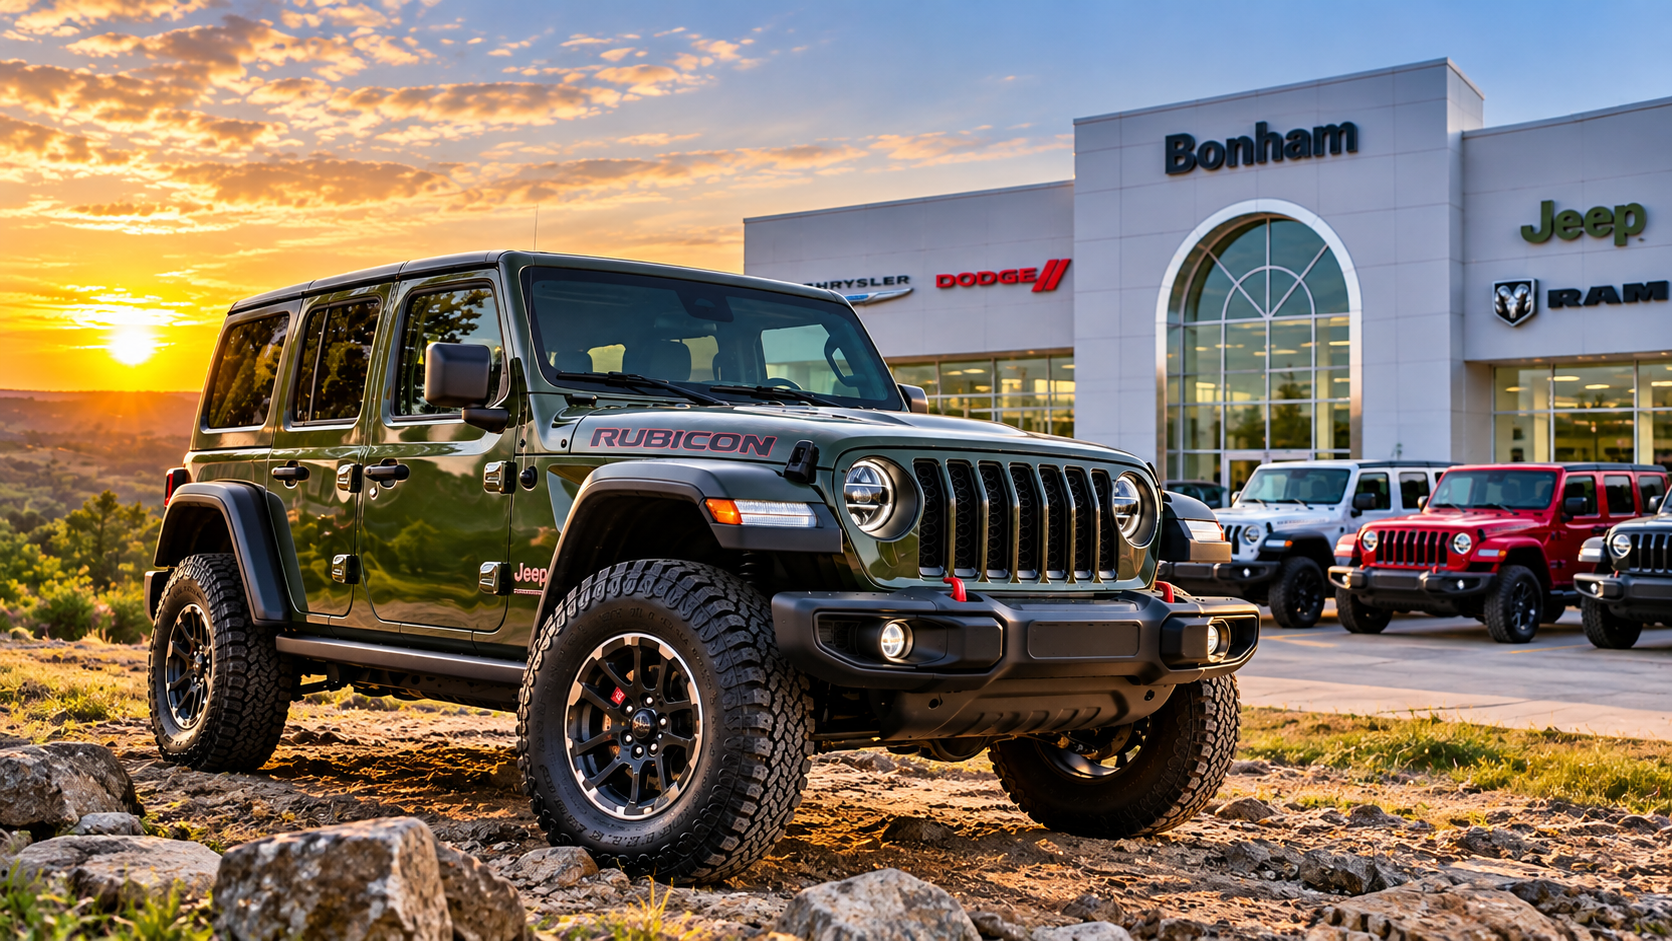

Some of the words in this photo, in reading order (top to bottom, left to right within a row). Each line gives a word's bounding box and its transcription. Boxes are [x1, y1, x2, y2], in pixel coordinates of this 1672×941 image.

[1165, 120, 1359, 175] Bonham
[1520, 199, 1647, 247] Jeep
[935, 266, 1038, 289] DODGE
[1547, 280, 1670, 309] RAM
[590, 427, 778, 458] RUBICON
[513, 562, 548, 588] Jeep
